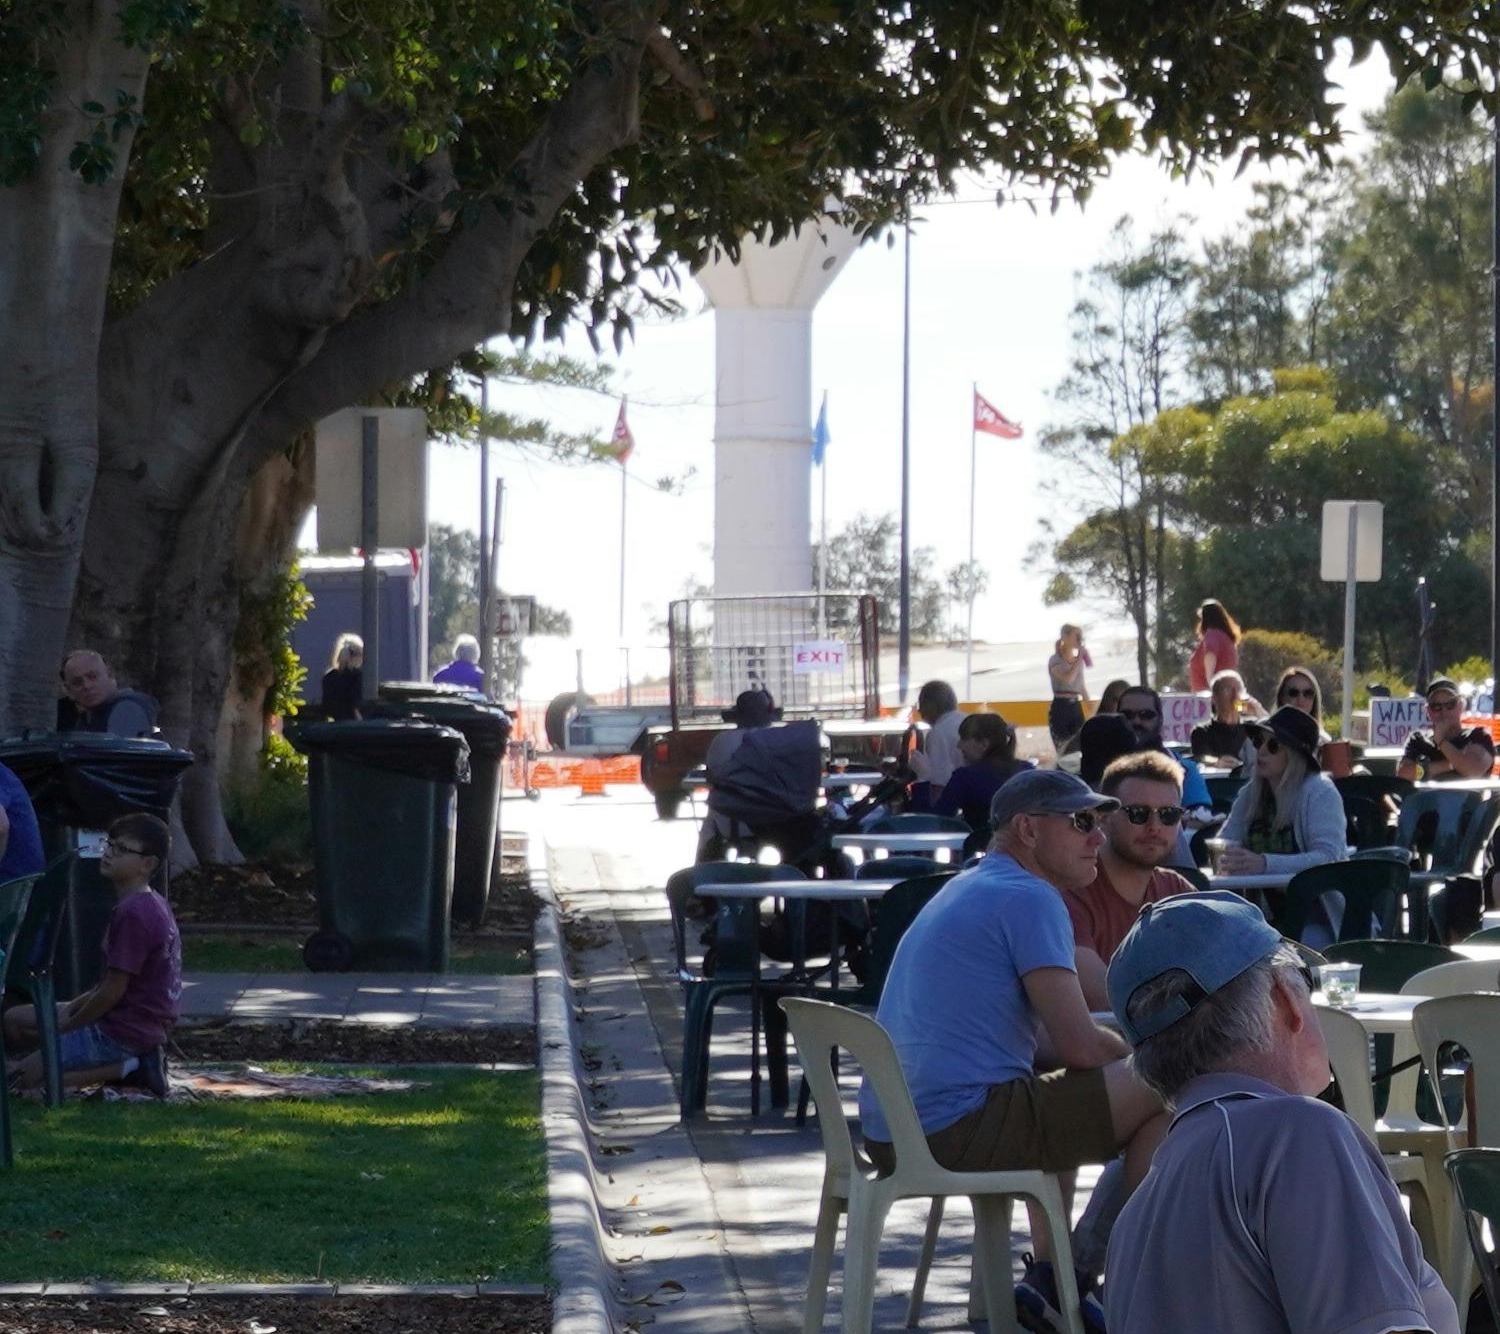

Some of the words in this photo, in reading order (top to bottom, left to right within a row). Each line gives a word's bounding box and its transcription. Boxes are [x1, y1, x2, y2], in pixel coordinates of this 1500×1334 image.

[796, 651, 843, 664] EXIT
[1173, 699, 1207, 721] COLD
[1377, 702, 1430, 722] WAFF
